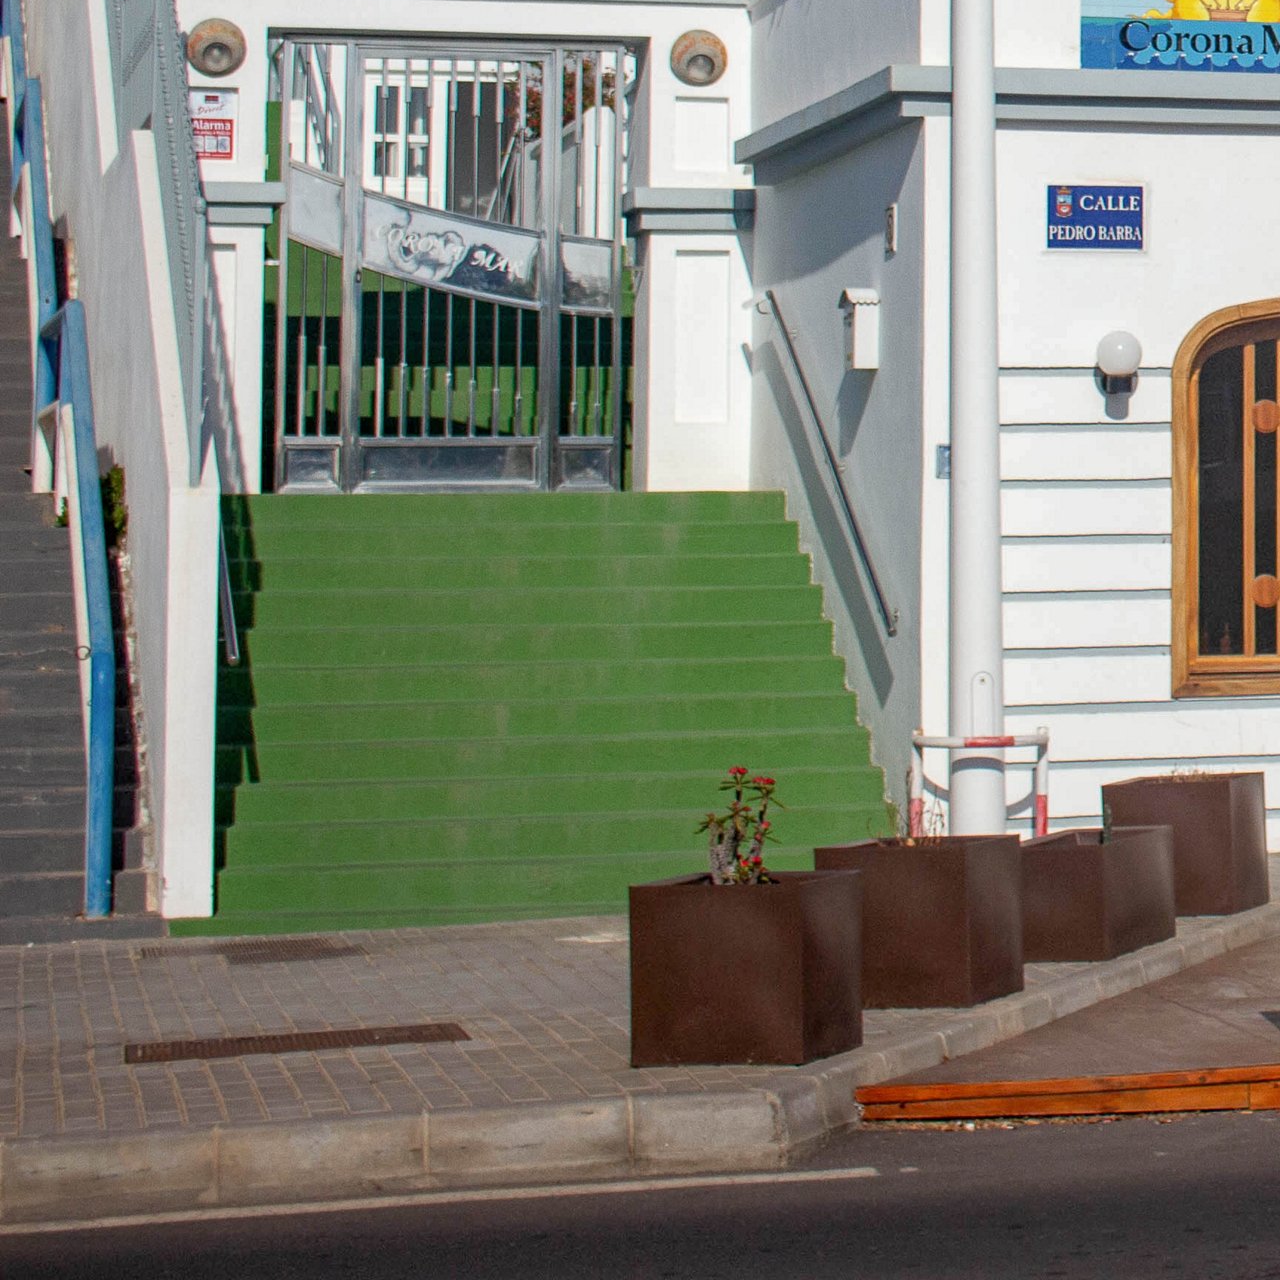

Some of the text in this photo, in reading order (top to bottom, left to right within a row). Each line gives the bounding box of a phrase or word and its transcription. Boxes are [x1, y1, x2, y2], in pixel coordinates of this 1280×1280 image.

[1119, 20, 1254, 55] Corona
[193, 120, 231, 131] Alarma
[1080, 195, 1140, 211] CALLE
[1049, 225, 1142, 240] PEDRO BARBA
